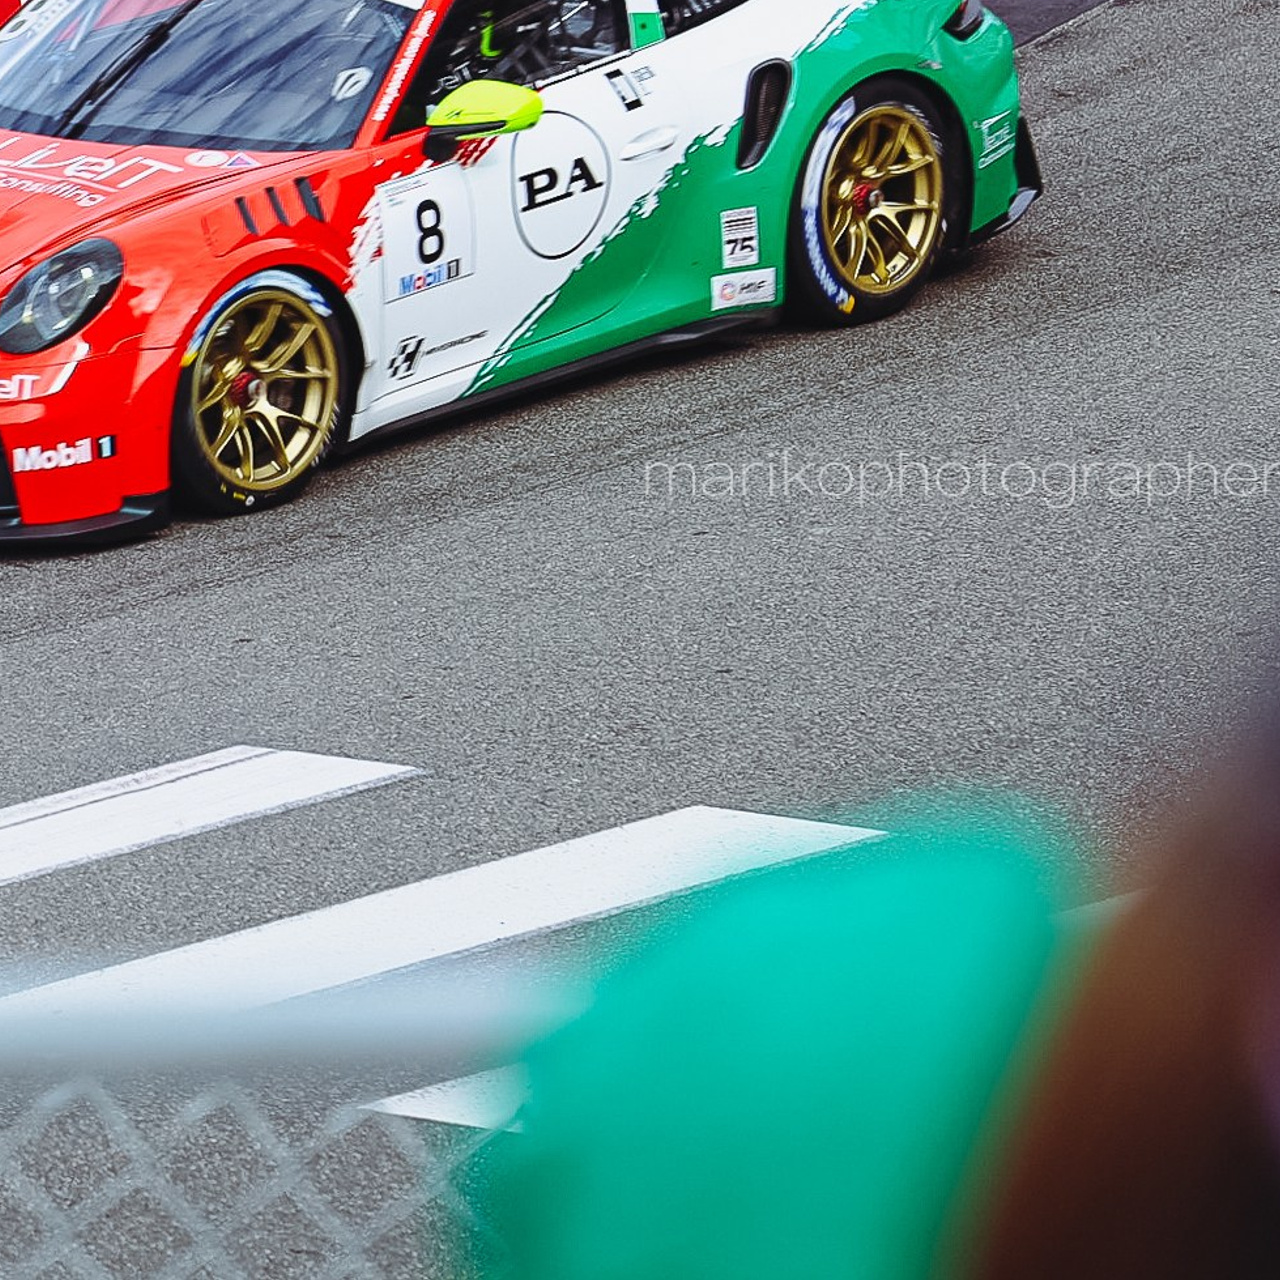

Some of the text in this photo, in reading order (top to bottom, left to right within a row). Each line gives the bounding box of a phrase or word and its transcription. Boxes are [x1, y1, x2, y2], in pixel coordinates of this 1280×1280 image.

[518, 156, 604, 213] PA
[416, 198, 445, 265] 8
[724, 235, 757, 256] 75
[399, 262, 445, 296] Mobil
[12, 435, 113, 473] Mobil 1
